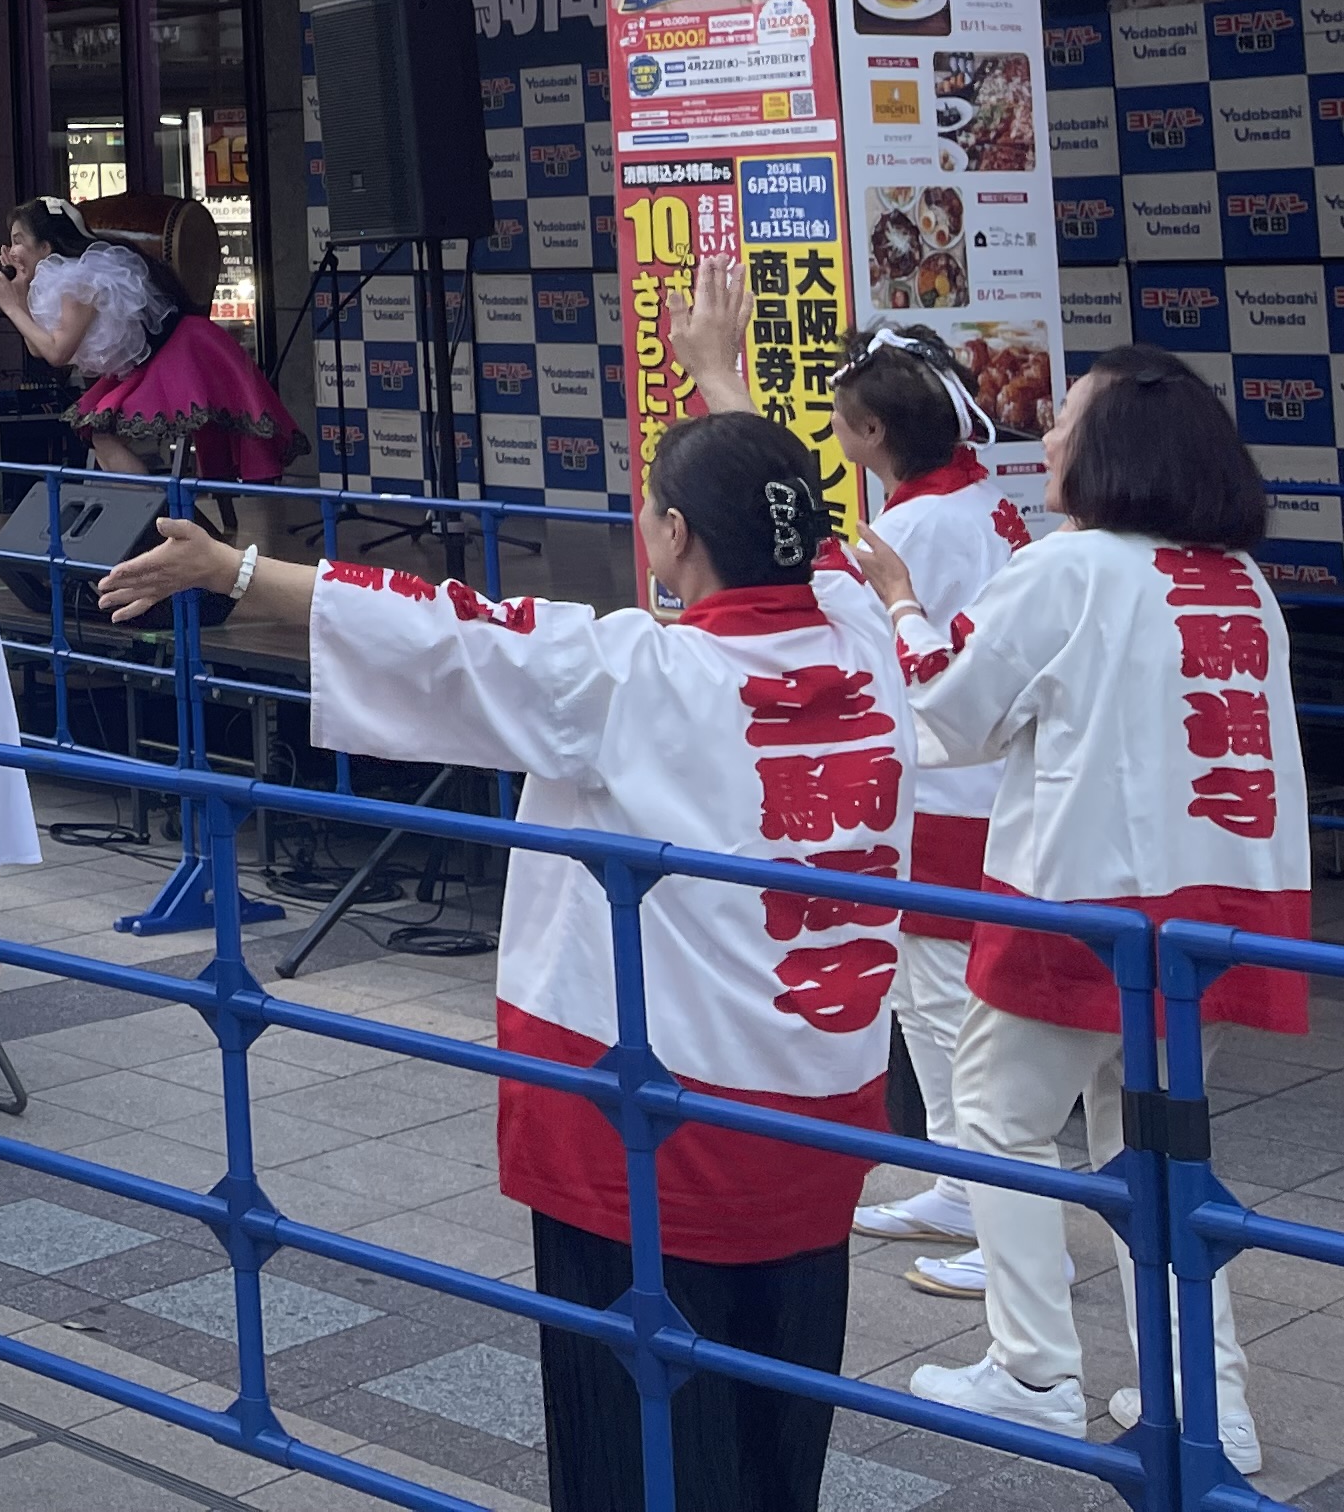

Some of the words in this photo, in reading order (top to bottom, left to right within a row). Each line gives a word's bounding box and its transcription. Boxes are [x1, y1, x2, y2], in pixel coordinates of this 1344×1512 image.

[1119, 21, 1198, 40] Yodobashi
[1214, 10, 1295, 35] ヨドバシ
[1044, 25, 1102, 46] ドバシ
[1236, 33, 1275, 53] 梅田
[1133, 45, 1187, 60] Umeda
[525, 76, 578, 90] Yodobashi
[534, 93, 570, 104] Umeda
[1126, 108, 1205, 131] ヨドバシ
[1219, 104, 1303, 123] Yodobashi
[1049, 116, 1109, 131] odobashi
[1148, 129, 1186, 148] 梅田
[1234, 127, 1291, 143] Umeda
[529, 144, 582, 163] ヨドバシ
[543, 161, 570, 178] 梅田
[623, 162, 732, 185] 消費税込み特価から
[766, 163, 802, 175] 2026年
[747, 176, 827, 194] 6月29日(月)
[769, 207, 805, 219] 2027年
[1132, 199, 1212, 216] Yodobashi
[1227, 193, 1309, 216] ヨドバシ
[533, 219, 586, 233] Yodobashi
[750, 219, 831, 239] 1月15日(金)
[1064, 219, 1097, 238] 梅田
[1146, 221, 1201, 236] Umeda
[1249, 215, 1289, 236] 梅田
[543, 236, 579, 248] Umeda
[365, 293, 411, 306] Yodobashi
[478, 292, 529, 306] Yodobashi
[537, 291, 590, 308] ヨドバシ
[1060, 291, 1122, 305] odobashi
[1140, 287, 1219, 309] ヨドバシ
[1235, 289, 1319, 305] Yodobashi
[373, 309, 405, 321] Umeda
[487, 309, 522, 322] Umeda
[552, 306, 578, 323] 梅田
[1062, 311, 1112, 326] Umeda
[1163, 306, 1201, 327] 梅田
[1249, 311, 1306, 326] Umeda
[369, 359, 413, 376] ヨドバシ
[482, 362, 533, 379] ヨドバシ
[542, 365, 595, 380] Yodobashi
[381, 374, 404, 391] 梅田
[495, 378, 521, 395] 梅田
[551, 382, 588, 396] Umeda
[632, 271, 670, 500] さらにお
[1242, 378, 1324, 401] ヨドバシ
[1265, 400, 1305, 420] 梅田
[486, 436, 538, 450] Yodobashi
[547, 437, 600, 455] ヨドバシ
[495, 452, 531, 466] Umeda
[562, 453, 588, 470] 梅田
